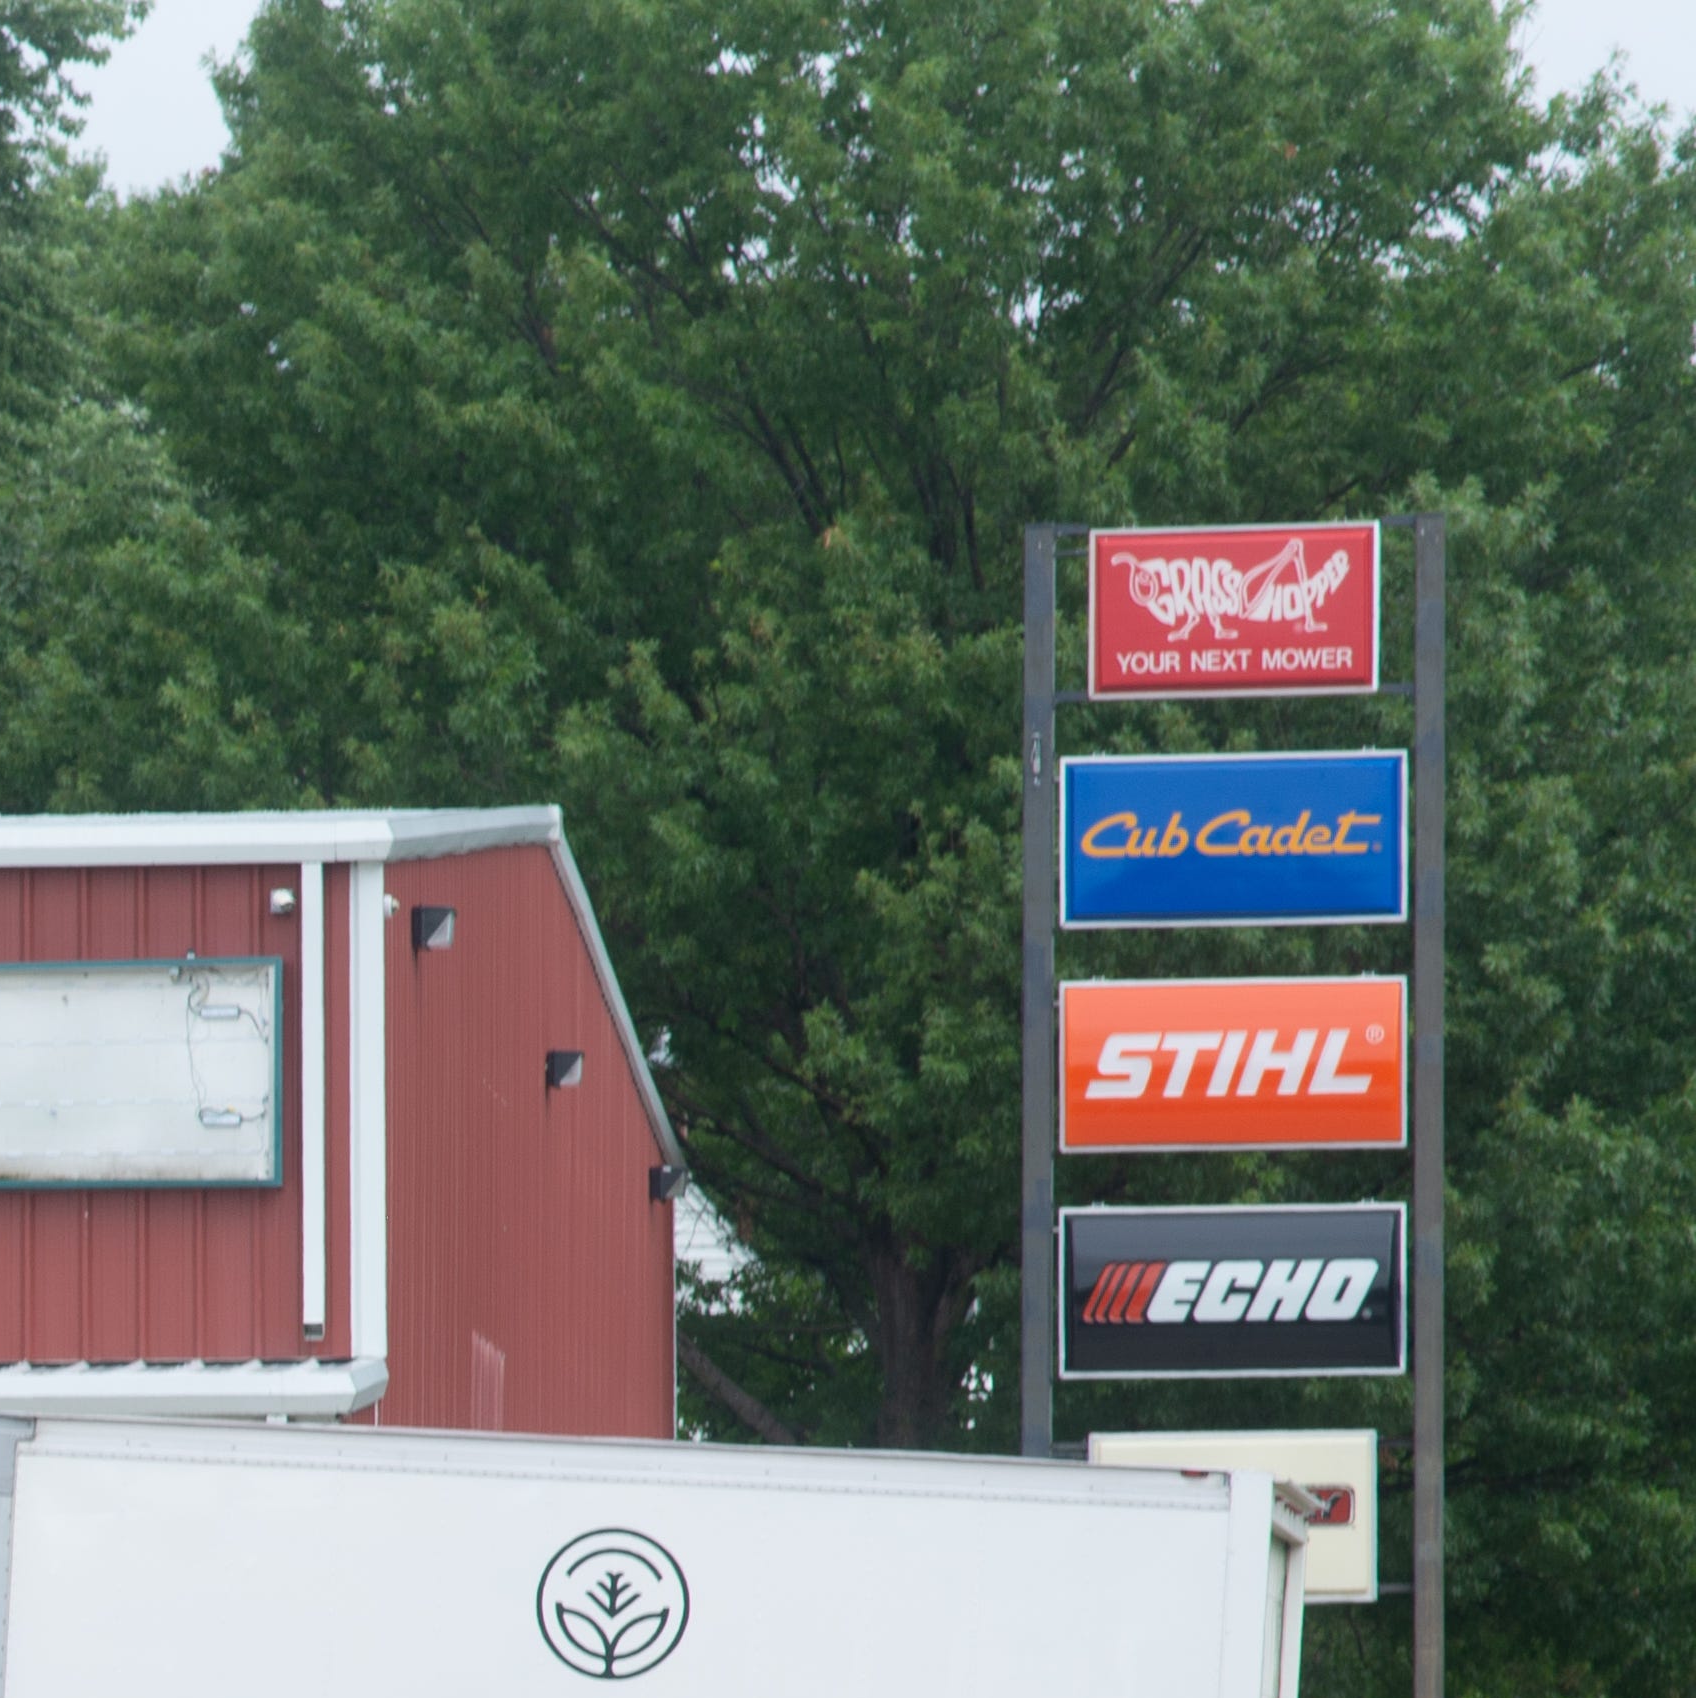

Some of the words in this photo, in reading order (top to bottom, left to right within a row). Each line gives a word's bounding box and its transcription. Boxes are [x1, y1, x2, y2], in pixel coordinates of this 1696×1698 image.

[1139, 549, 1350, 627] GRASSHOPPER
[1116, 652, 1180, 675] YOUR
[1190, 649, 1252, 673] NEXT
[1261, 646, 1353, 672] MOWER
[1080, 811, 1189, 858] Cub
[1195, 810, 1382, 857] Cadet
[1084, 1028, 1373, 1099] STIHL
[1146, 1257, 1380, 1323] ECHO
